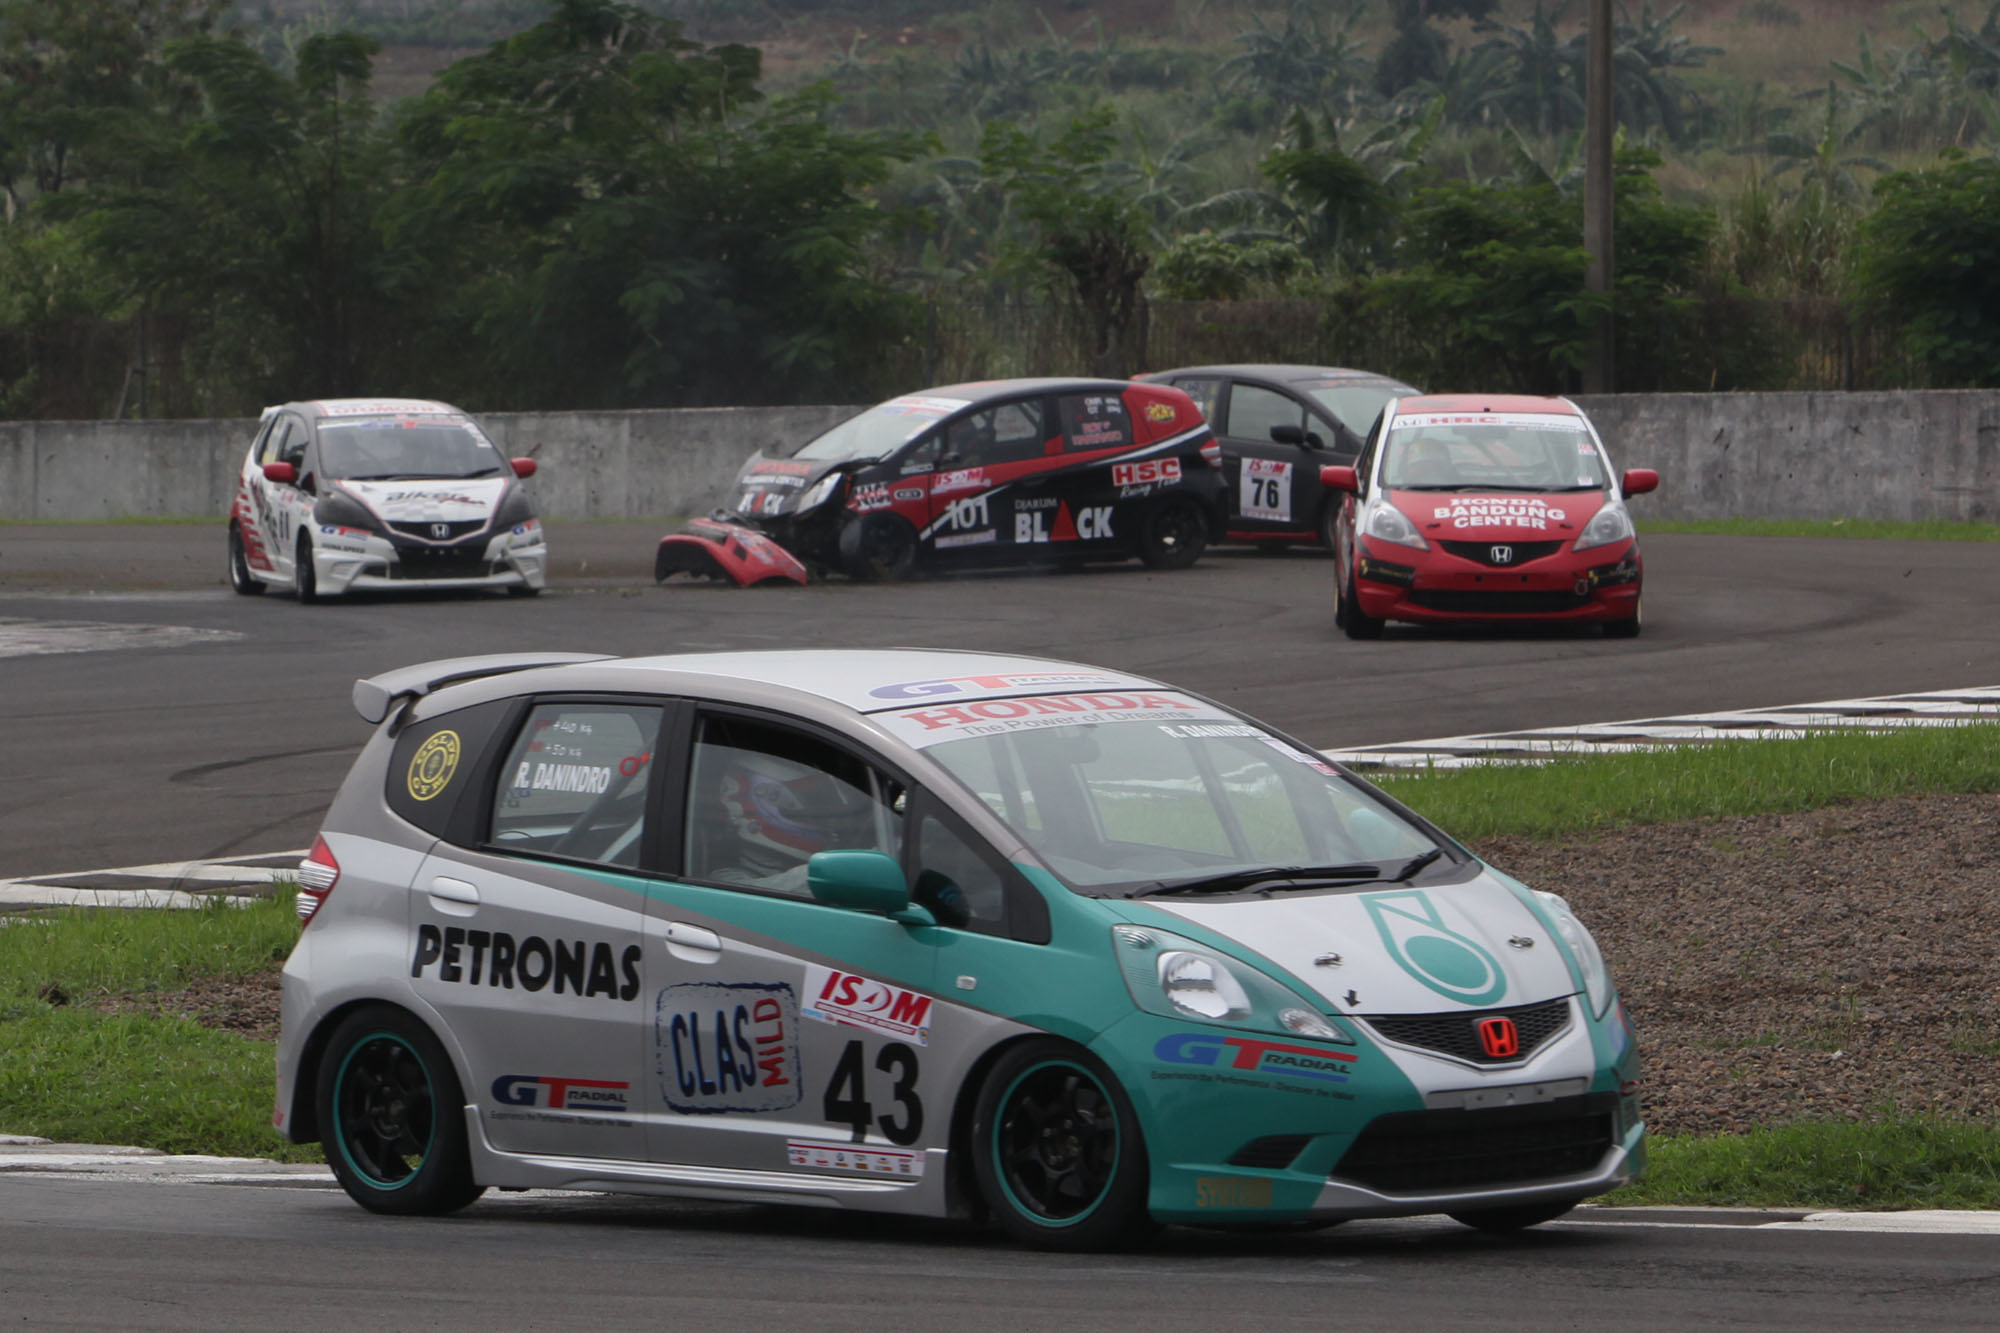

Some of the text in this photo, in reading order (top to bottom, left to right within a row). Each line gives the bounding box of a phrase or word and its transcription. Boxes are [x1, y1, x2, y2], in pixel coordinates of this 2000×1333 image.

[1114, 459, 1179, 485] HSC
[1015, 498, 1058, 511] DJARUM
[1252, 478, 1279, 509] 76
[1450, 497, 1548, 508] HONDA
[1015, 498, 1114, 543] BLACK
[1434, 506, 1566, 521] BANDUNG
[1453, 515, 1547, 530] CENTER
[868, 672, 1103, 700] GT
[900, 693, 1201, 731] HONDA
[955, 709, 1197, 737] The Power of Dreams
[514, 761, 612, 794] R. DANINDRO
[411, 924, 641, 1002] PETRONAS
[670, 1003, 757, 1098] CLAS
[753, 997, 790, 1088] MILD
[1153, 1033, 1359, 1075] GT RADIAL
[490, 1073, 631, 1109] GT RADIAL
[823, 1039, 925, 1147] 43
